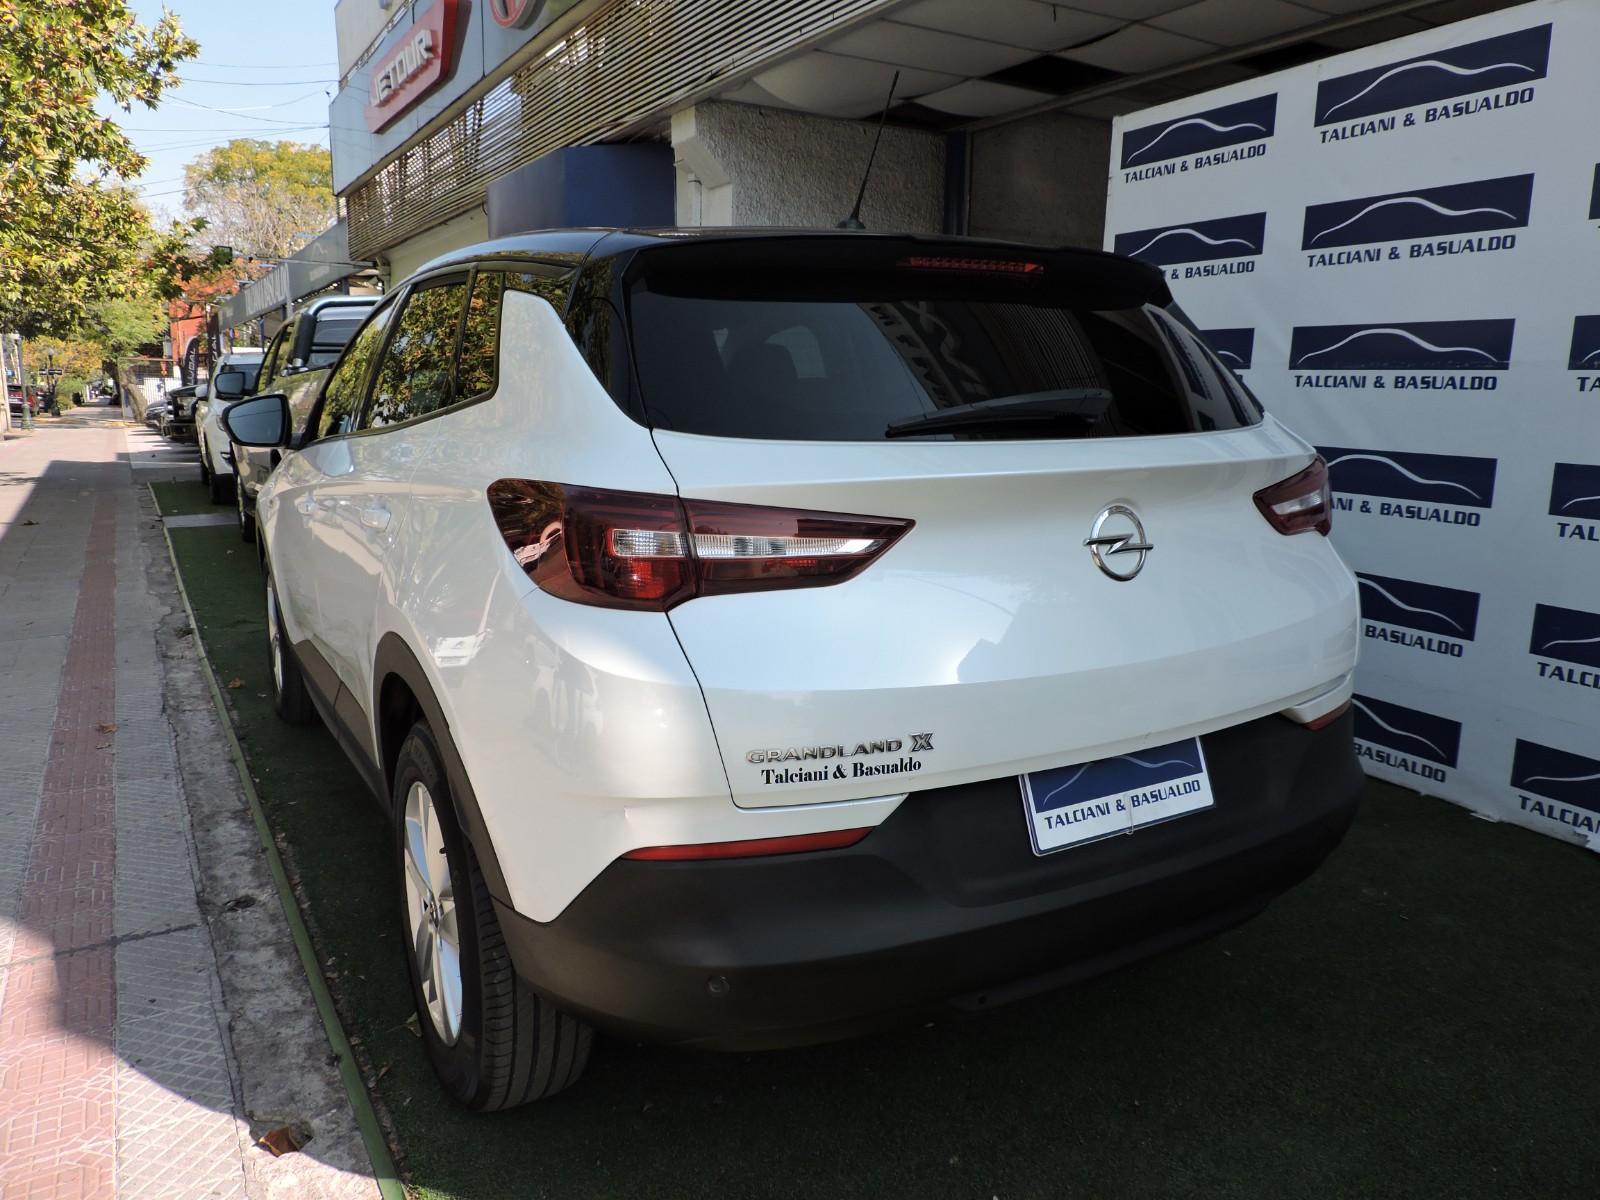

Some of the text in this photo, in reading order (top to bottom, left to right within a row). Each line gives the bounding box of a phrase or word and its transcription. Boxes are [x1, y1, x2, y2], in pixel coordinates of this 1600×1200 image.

[1320, 87, 1535, 144] TALCIANI & BASUALDO
[1124, 144, 1267, 184] TALCIANI & BASUALDO
[1307, 234, 1517, 268] TALCIANI & BASUALDO
[1170, 268, 1180, 280] &
[1184, 260, 1255, 279] BASUALDO
[1294, 375, 1498, 391] TALCIANI & BASUALDO
[1359, 500, 1372, 513] &
[1379, 502, 1481, 527] BASUALDO
[1365, 624, 1463, 657] BASUALDO
[746, 732, 935, 763] GRANDLAND X
[1353, 742, 1446, 783] BASUALDO
[761, 756, 922, 785] Talciani & Basualdo
[1044, 779, 1201, 830] TALCIANI & BASUALDO
